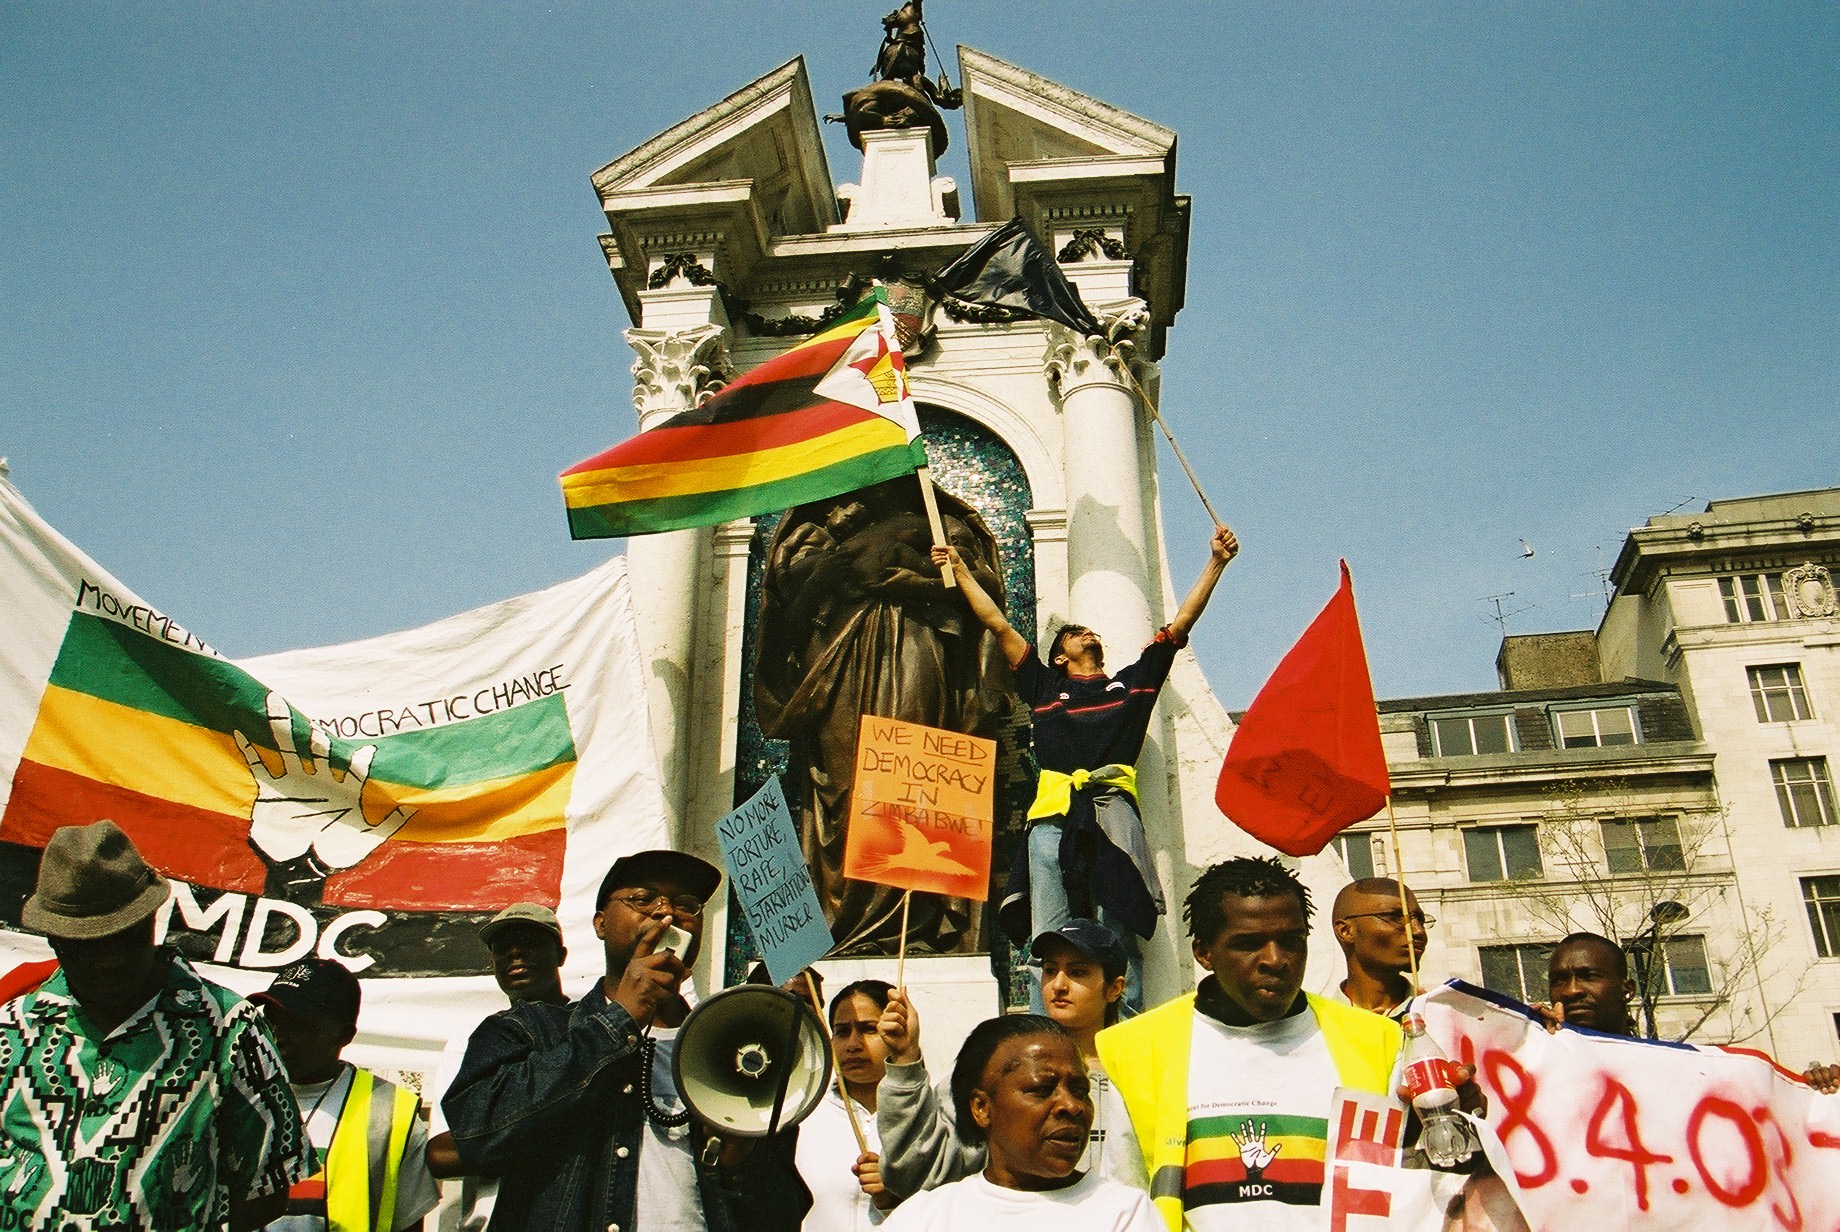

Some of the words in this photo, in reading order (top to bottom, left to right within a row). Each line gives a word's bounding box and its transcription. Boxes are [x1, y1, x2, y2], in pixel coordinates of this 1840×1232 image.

[76, 578, 217, 656] MOVEMEN
[473, 664, 571, 714] CHANGE
[873, 723, 912, 745] WE
[923, 731, 987, 761] NEED
[863, 747, 987, 795] DEMOCRACY
[897, 782, 939, 806] IN
[719, 814, 745, 845] NO
[744, 784, 780, 829] MORE
[152, 877, 388, 973] MDC
[759, 901, 813, 953] MURDER
[1212, 1100, 1250, 1109] Democratic
[1252, 1099, 1278, 1107] Change
[1238, 1184, 1274, 1198] MDC
